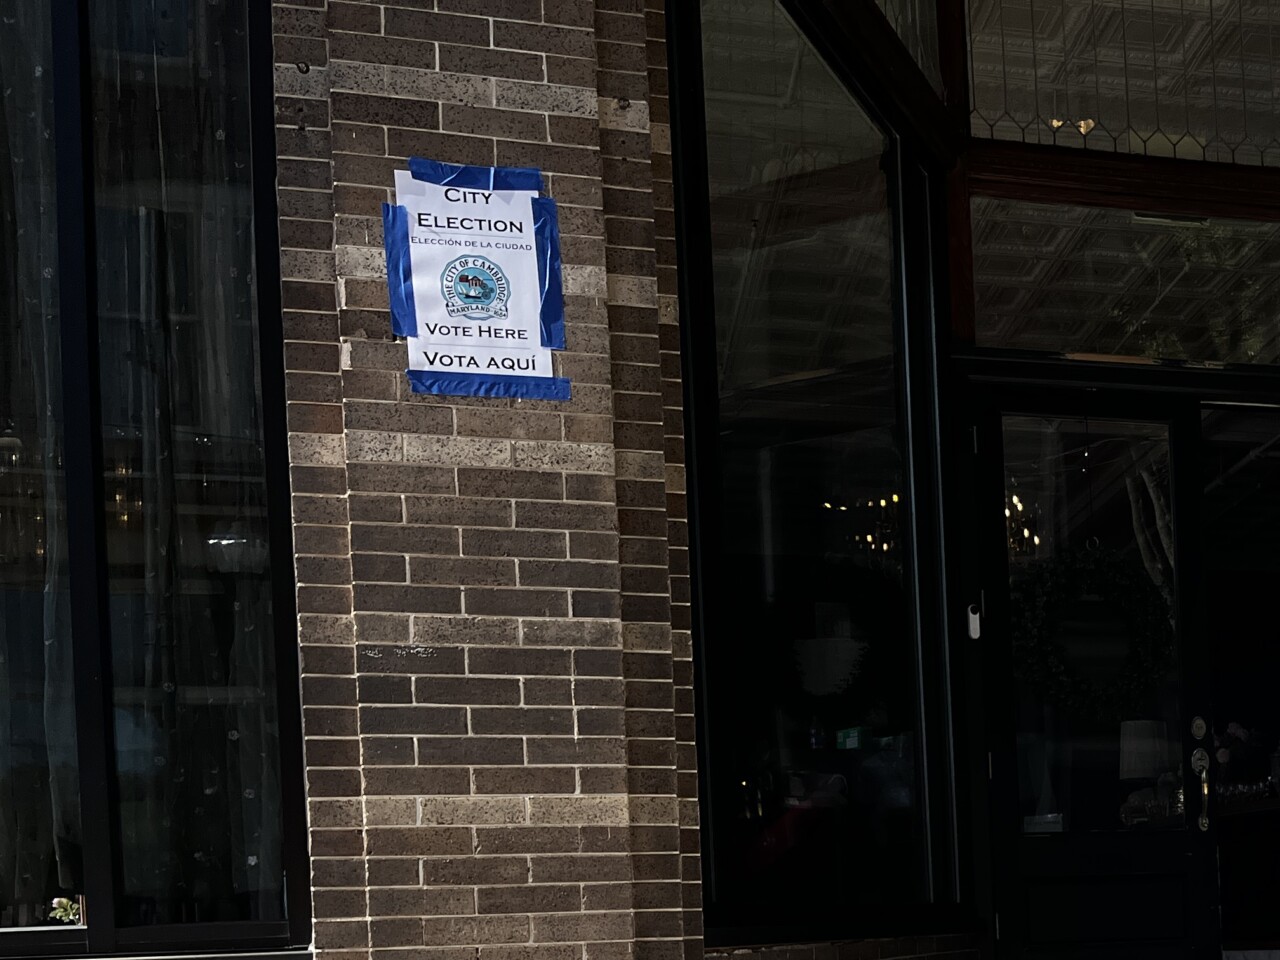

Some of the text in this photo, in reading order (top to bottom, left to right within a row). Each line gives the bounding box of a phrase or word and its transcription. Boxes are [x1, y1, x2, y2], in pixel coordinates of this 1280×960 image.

[444, 188, 492, 205] CITY
[417, 212, 523, 234] ELECTION
[464, 240, 478, 248] DE
[480, 241, 493, 249] LA
[445, 264, 460, 283] CITY
[459, 259, 470, 268] OF
[472, 259, 507, 305] CAMBRIDGE
[449, 304, 490, 315] MARYLAND
[425, 322, 528, 340] VOTE HERE
[422, 351, 537, 371] VOTA AQUÍ
